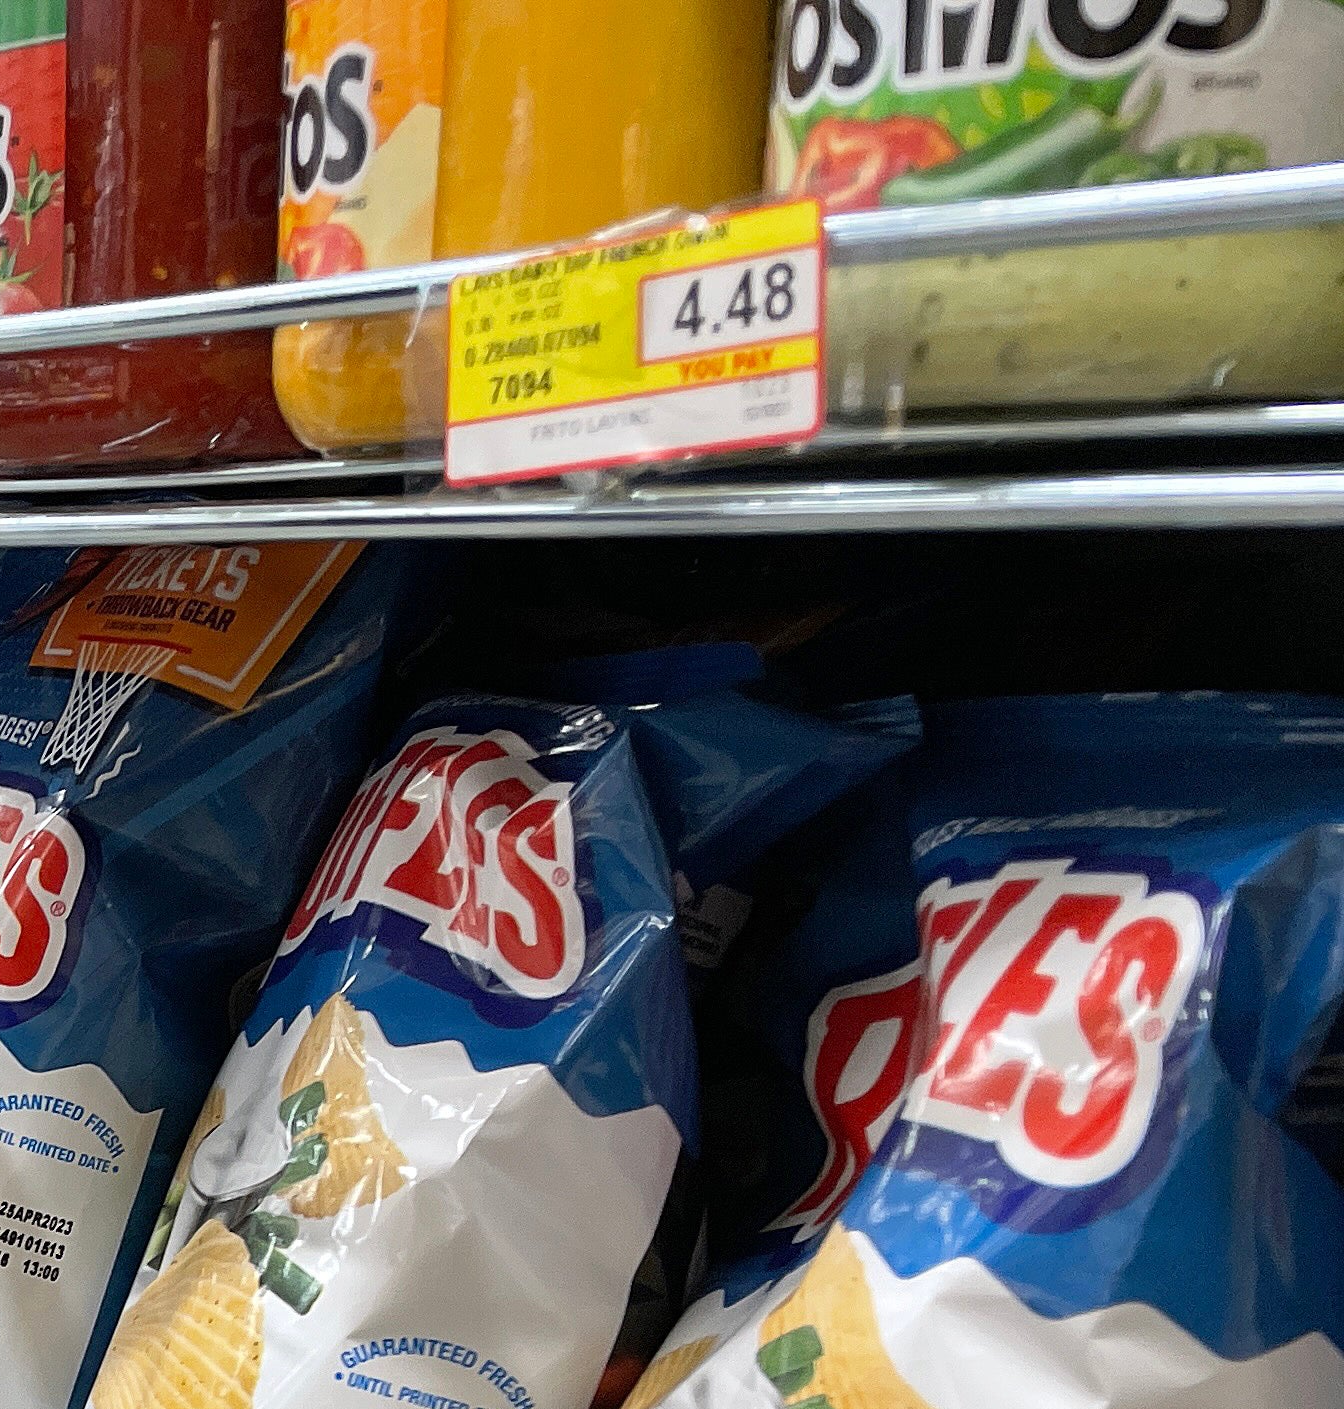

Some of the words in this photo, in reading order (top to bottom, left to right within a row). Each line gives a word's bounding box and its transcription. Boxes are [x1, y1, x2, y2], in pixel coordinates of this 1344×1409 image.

[673, 262, 795, 338] 4.48
[489, 367, 554, 405] 7094
[678, 356, 726, 383] YOU
[106, 546, 259, 599] TICKETS
[181, 603, 238, 634] GEAR
[84, 1113, 126, 1159] FRESH
[18, 1135, 76, 1163] PRINTED
[78, 1153, 112, 1174] DATE
[23, 1259, 60, 1282] 13:00
[340, 1337, 479, 1369] GUARANTEED
[346, 1371, 394, 1398] UNTIL
